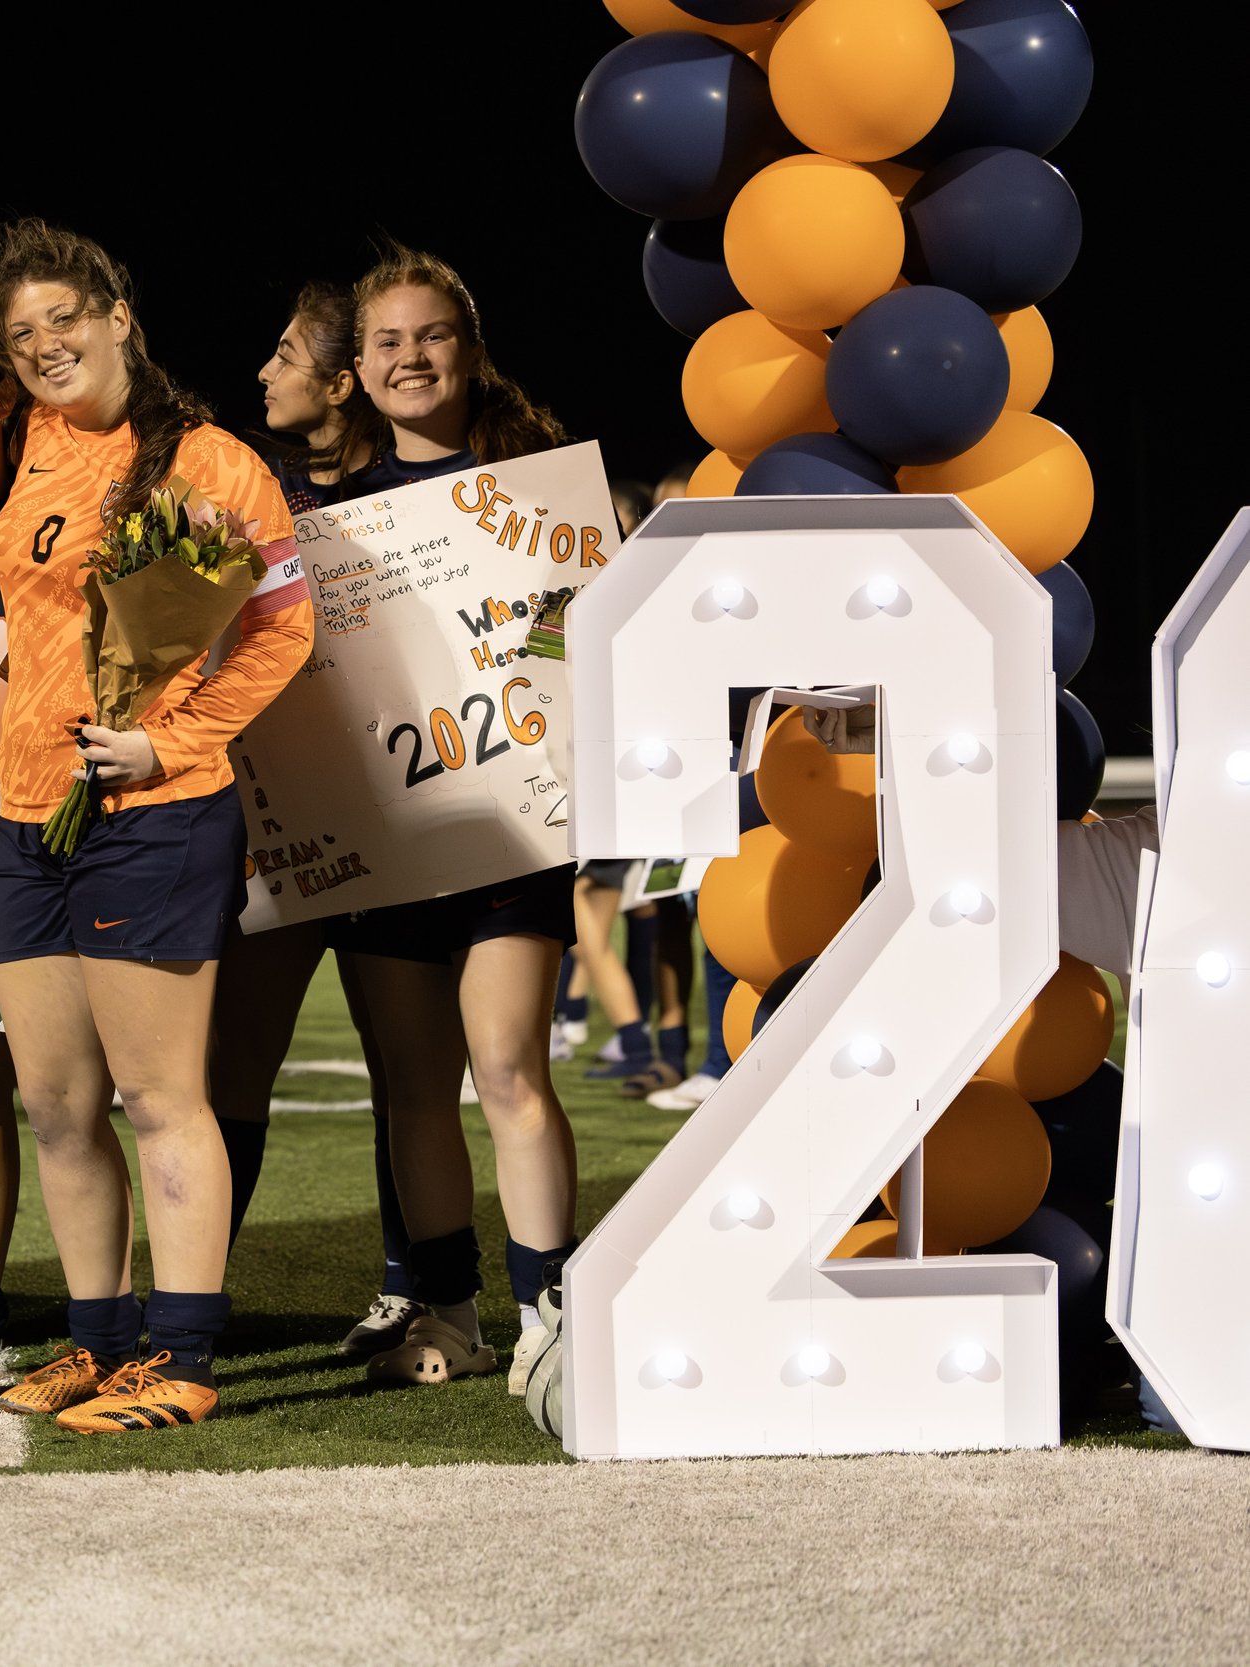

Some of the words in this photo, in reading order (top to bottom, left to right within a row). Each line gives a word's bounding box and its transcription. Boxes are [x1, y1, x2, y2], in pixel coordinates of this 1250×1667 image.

[322, 505, 362, 527] Shall
[372, 499, 392, 512] be
[341, 515, 395, 541] missed
[31, 514, 66, 565] 0
[312, 558, 374, 583] Goalies
[383, 550, 403, 564] are
[410, 536, 450, 556] there
[323, 604, 345, 618] fail
[350, 596, 371, 609] not
[377, 584, 412, 601] when
[417, 574, 439, 590] you
[346, 578, 369, 596] you
[377, 566, 410, 581] when
[419, 555, 442, 571] you
[470, 640, 528, 672] Hero
[387, 677, 547, 788] 2026
